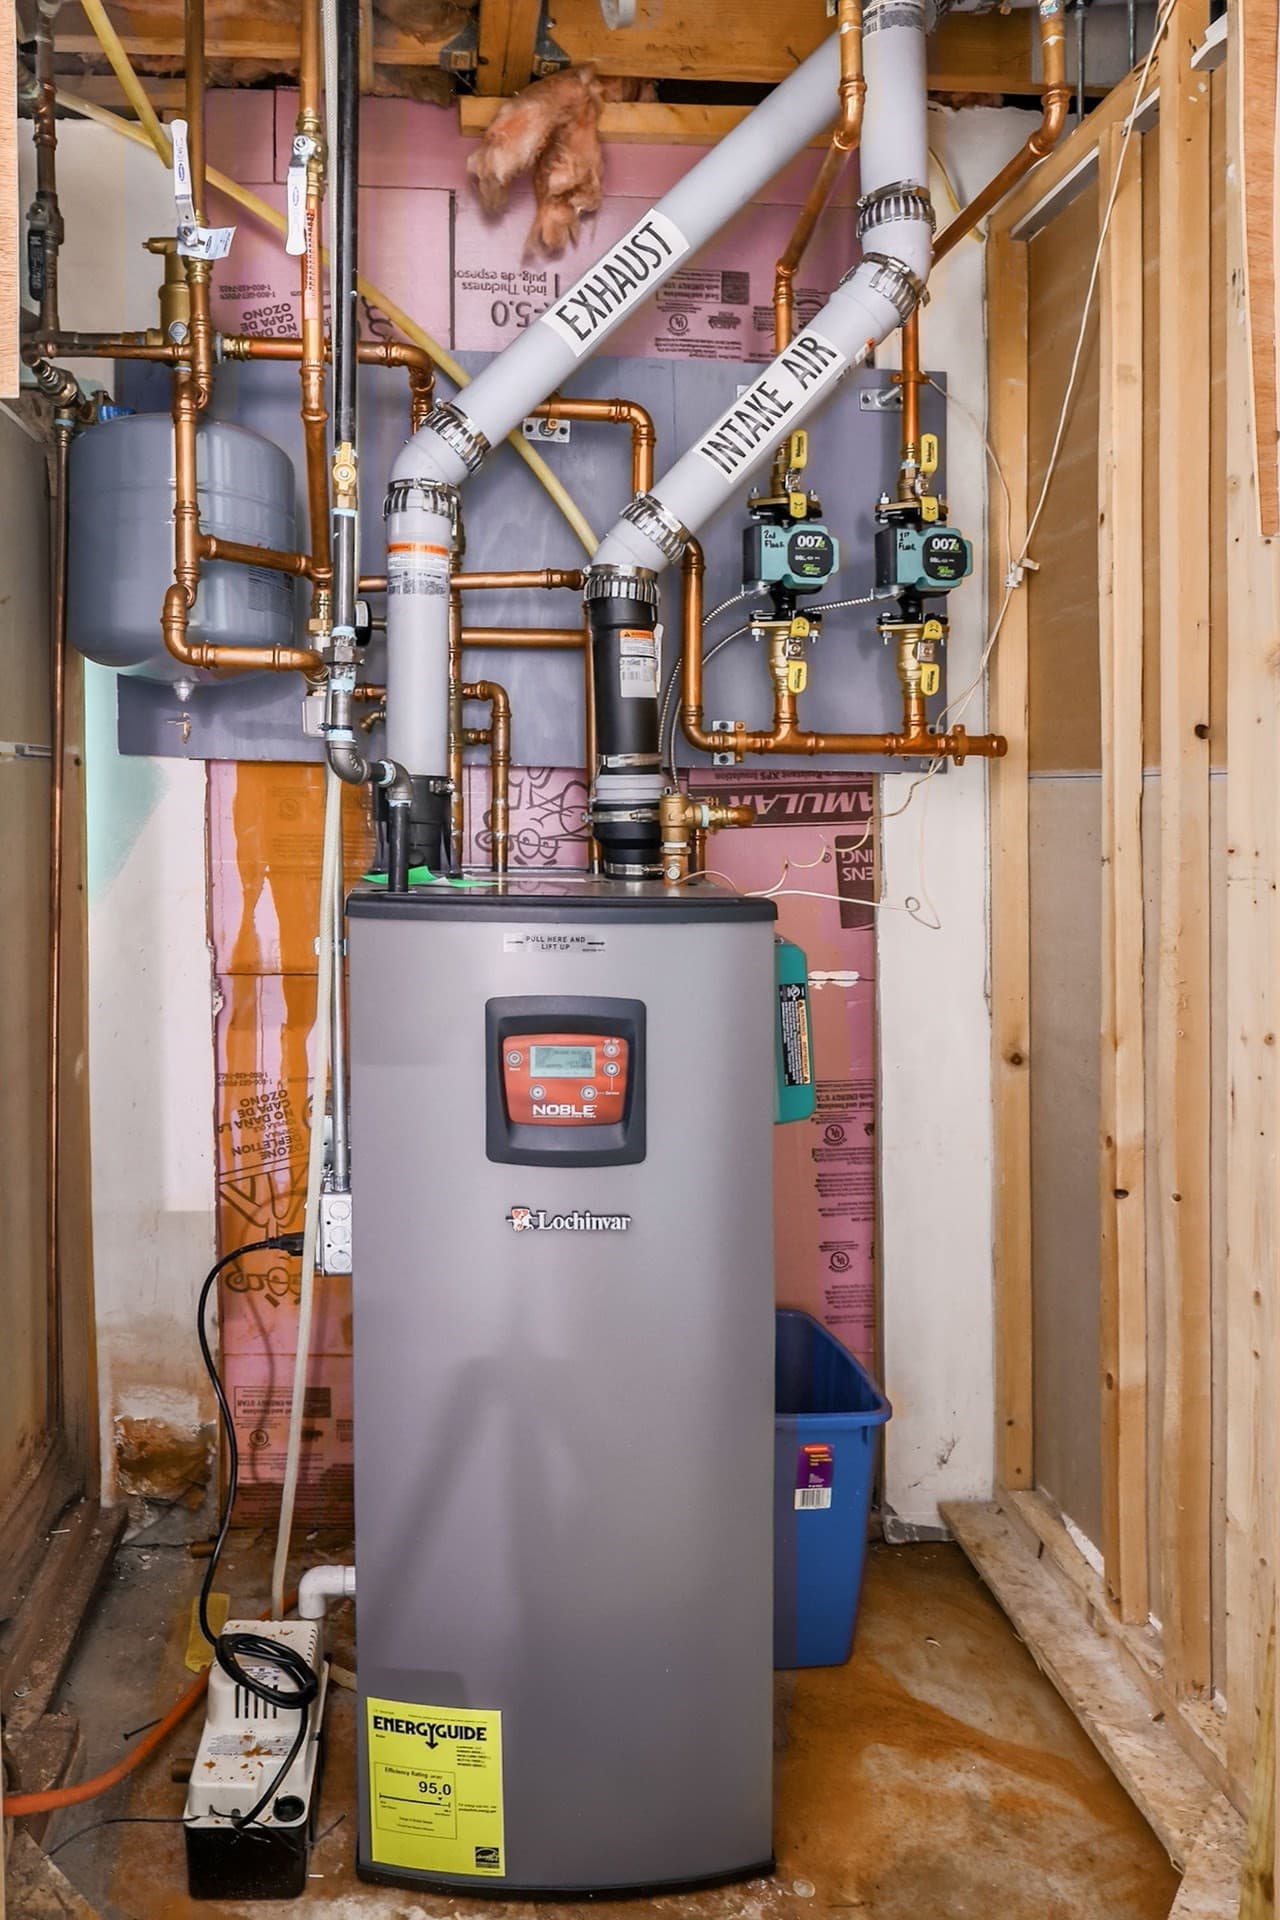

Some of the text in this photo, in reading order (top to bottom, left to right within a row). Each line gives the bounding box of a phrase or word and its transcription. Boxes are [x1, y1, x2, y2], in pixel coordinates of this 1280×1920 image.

[453, 268, 497, 280] espeso
[500, 272, 516, 282] de
[555, 221, 672, 340] EXHAUST
[462, 282, 547, 296] inch Thickness
[242, 303, 291, 321] OZONO
[491, 300, 549, 327] -5.0
[240, 313, 294, 332] CAPA DE
[277, 322, 298, 334] NO
[700, 381, 794, 474] INTAKE
[781, 337, 838, 390] AIR
[240, 1089, 287, 1107] OZONO
[237, 1099, 290, 1118] CAPA DE
[532, 1104, 595, 1116] NOBLE
[536, 1210, 632, 1231] Lochinvar
[373, 1715, 488, 1742] ENERGYGUIDE
[384, 1766, 410, 1777] Efficiency
[411, 1771, 429, 1779] Rating
[418, 1781, 452, 1796] 95.0
